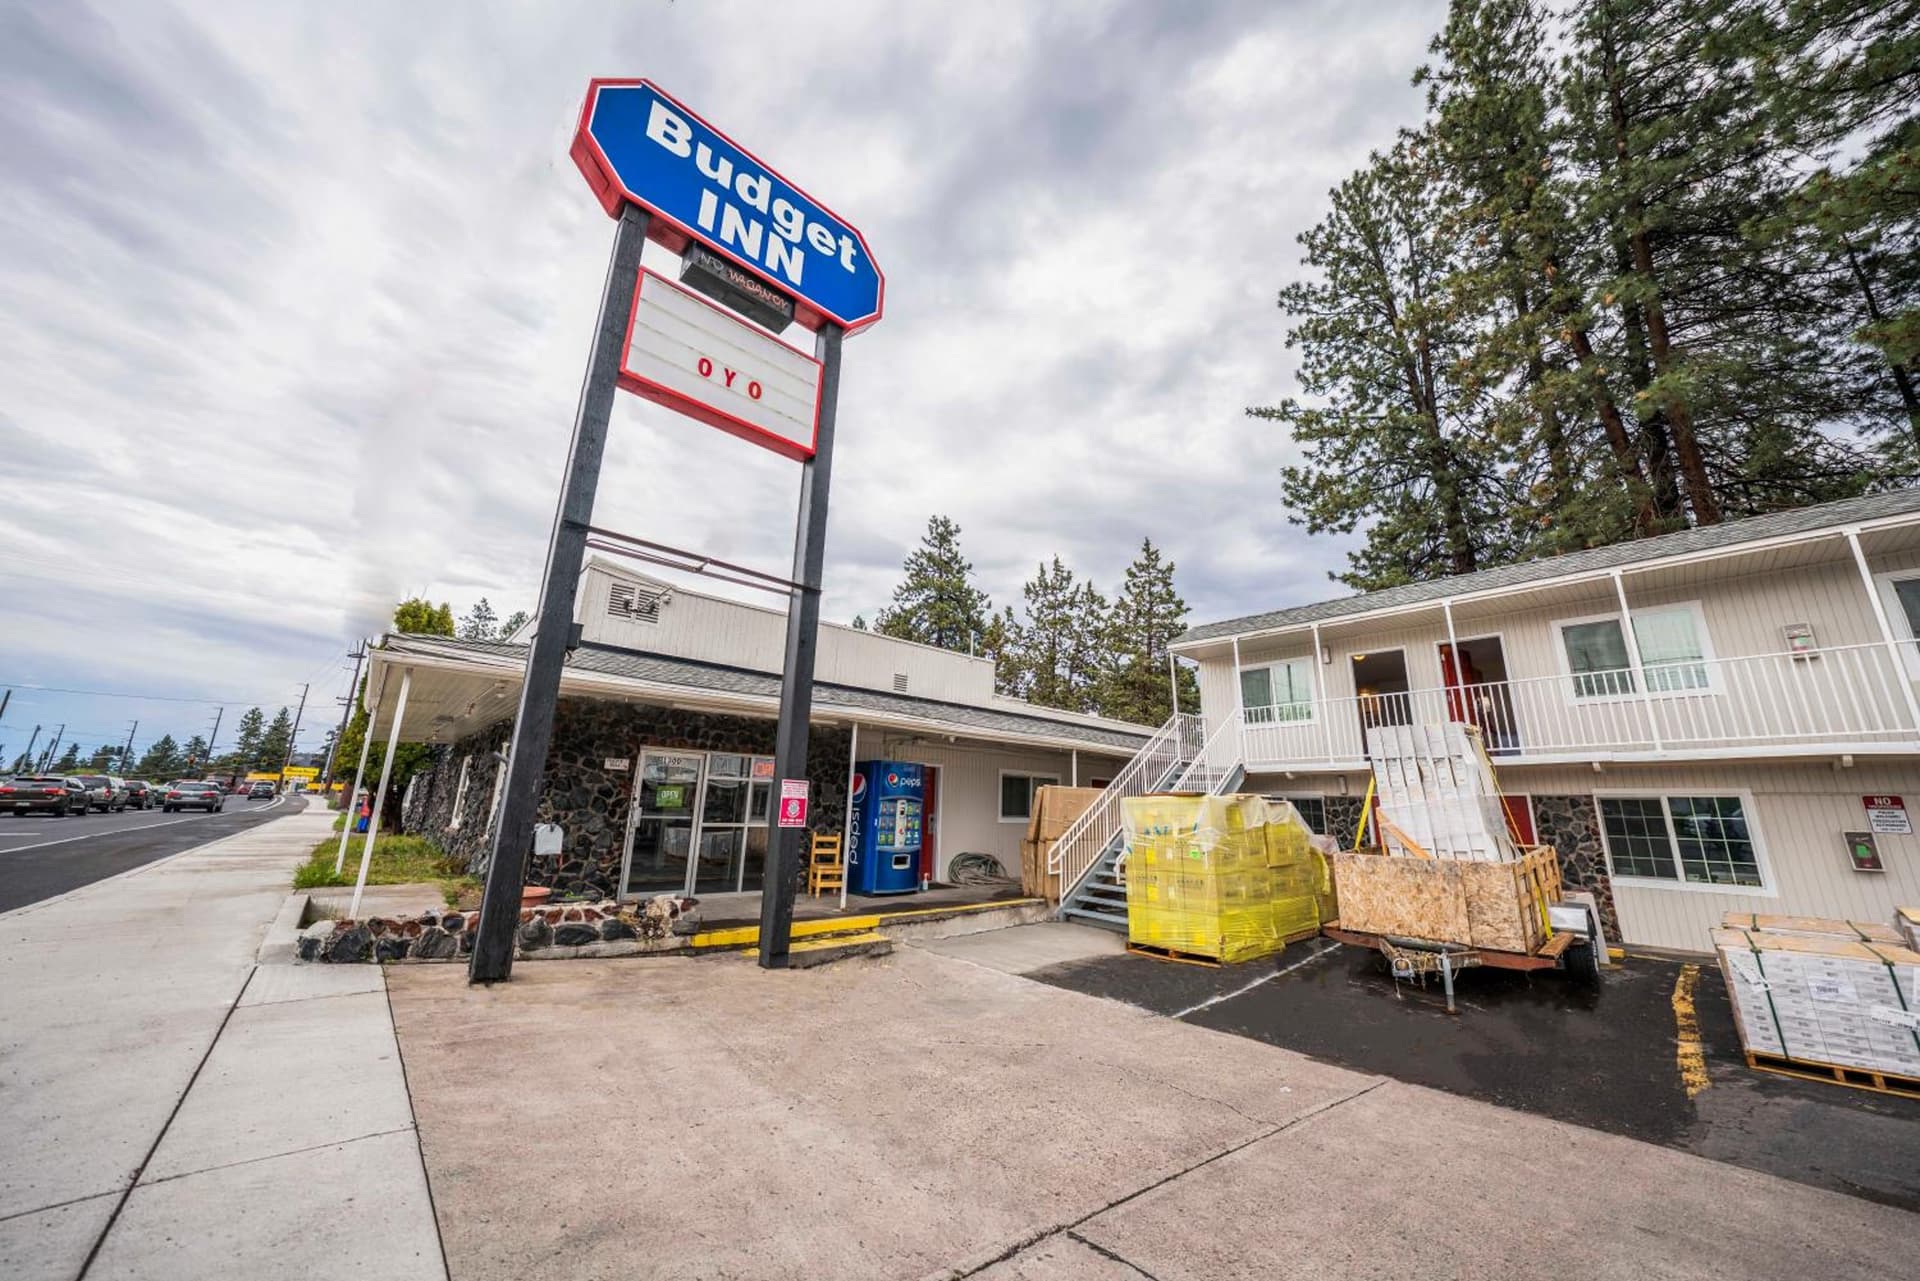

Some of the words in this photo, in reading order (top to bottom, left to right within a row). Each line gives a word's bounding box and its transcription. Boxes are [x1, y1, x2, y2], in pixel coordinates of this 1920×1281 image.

[646, 100, 857, 273] Budget
[697, 188, 805, 286] INN
[661, 790, 678, 799] OPEN
[900, 777, 921, 788] peps
[1873, 797, 1892, 805] NO
[849, 807, 860, 864] pepsi
